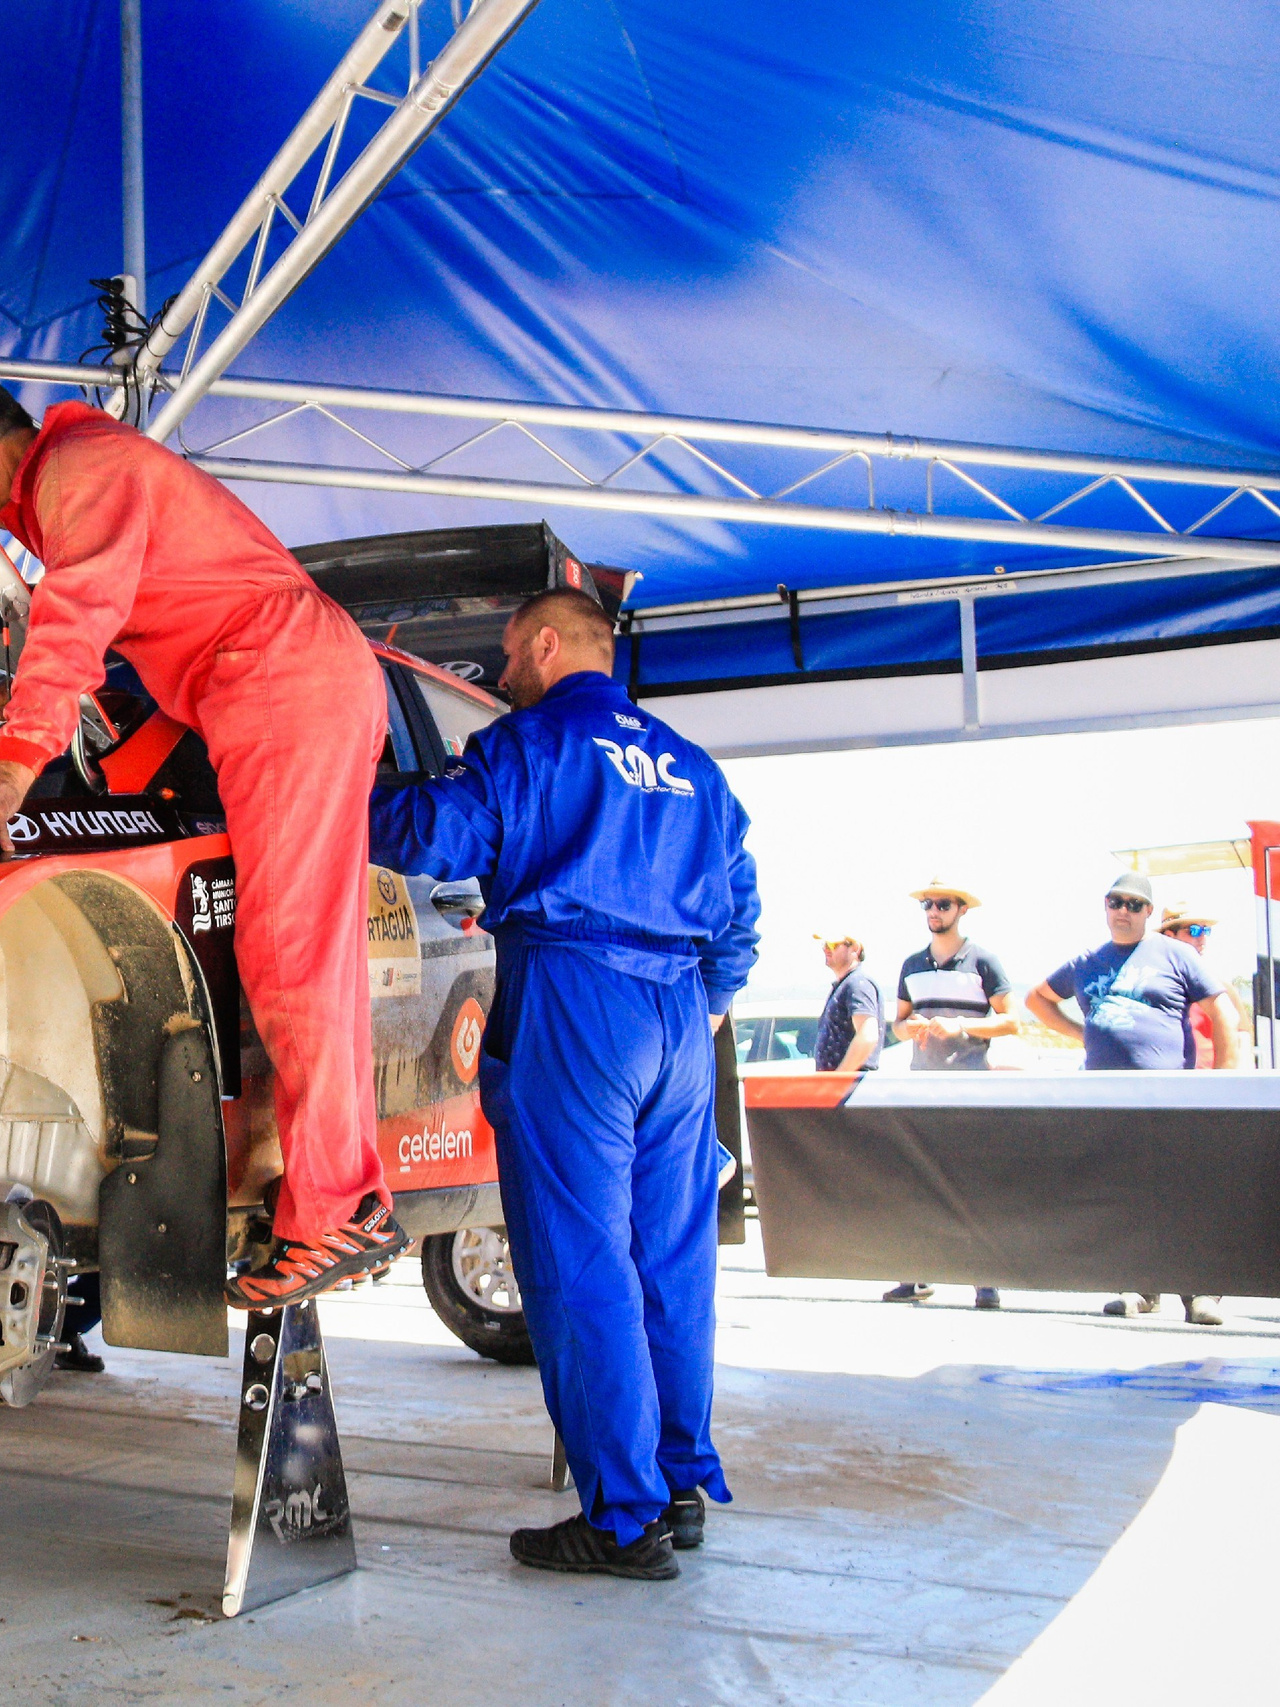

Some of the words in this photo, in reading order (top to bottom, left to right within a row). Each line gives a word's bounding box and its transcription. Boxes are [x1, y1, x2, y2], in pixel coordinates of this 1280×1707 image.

[640, 785, 695, 797] motorsport
[40, 810, 164, 837] HYUNDAI
[212, 888, 236, 900] MUNICIP
[399, 1121, 473, 1173] cetelem
